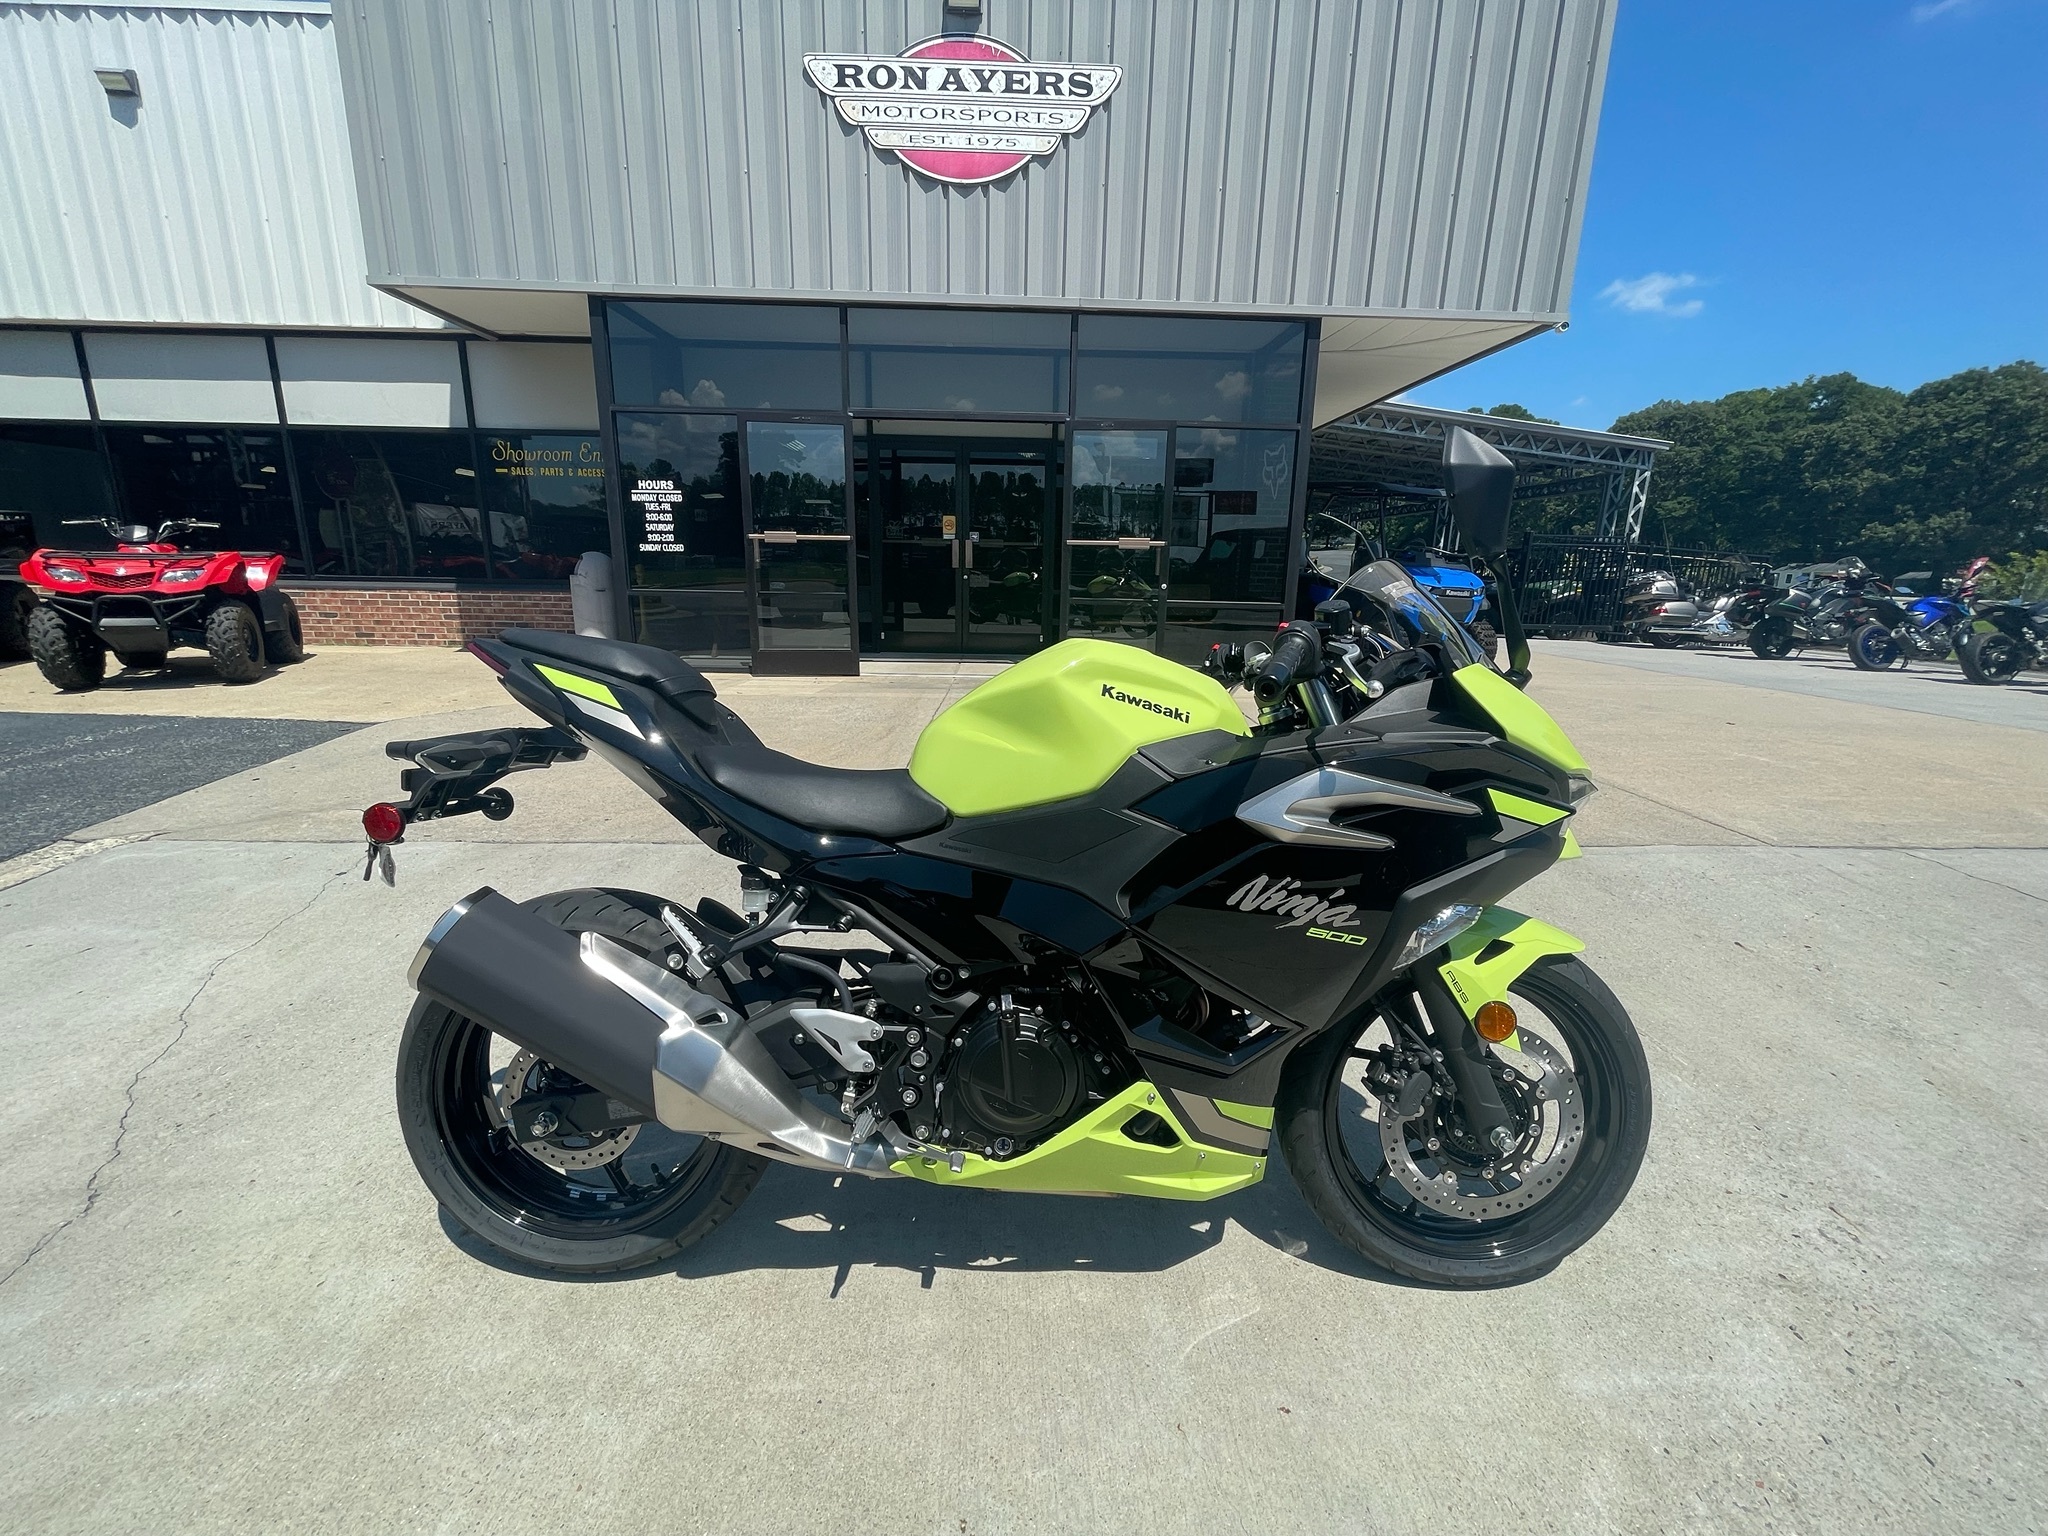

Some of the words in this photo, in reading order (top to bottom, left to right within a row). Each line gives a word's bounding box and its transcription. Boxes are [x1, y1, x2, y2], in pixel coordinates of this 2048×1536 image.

[833, 63, 927, 91] RON
[938, 66, 1094, 97] AYERS
[861, 105, 1064, 124] MOTORSPORTS
[909, 134, 952, 145] EST.
[967, 136, 1017, 148] 1975
[492, 440, 572, 463] Showroom
[540, 467, 564, 477] PARTS
[568, 468, 574, 476] &
[638, 479, 674, 490] HOURS
[631, 493, 657, 501] MONDAY
[658, 494, 683, 502] CLOSED
[645, 512, 673, 521] 9:00-6:00
[645, 523, 675, 532] SATURDAY
[647, 533, 675, 542] 9:00-2:00
[639, 543, 662, 552] SUNDAY
[662, 543, 685, 552] CLOSED
[1445, 589, 1471, 597] Kawasaki
[1101, 683, 1191, 724] Kawasaki
[1226, 874, 1361, 930] Ninja
[1305, 927, 1368, 946] 500
[1445, 970, 1470, 1004] ABS
